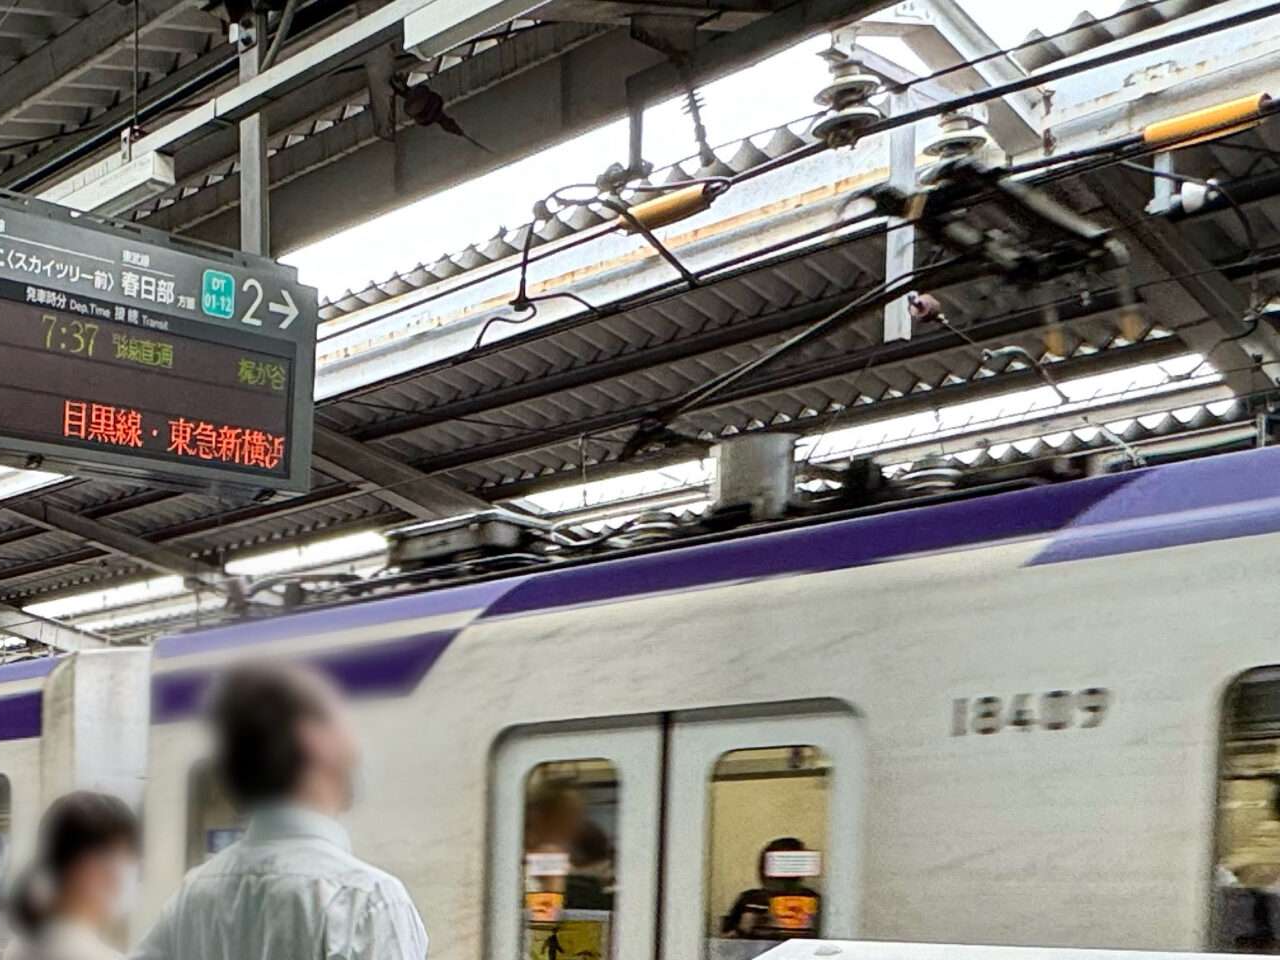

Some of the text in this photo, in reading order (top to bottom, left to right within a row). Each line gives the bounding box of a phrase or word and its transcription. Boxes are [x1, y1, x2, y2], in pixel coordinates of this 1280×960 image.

[121, 271, 175, 305] 春日部
[241, 278, 264, 326] 2
[41, 314, 98, 357] 7:37
